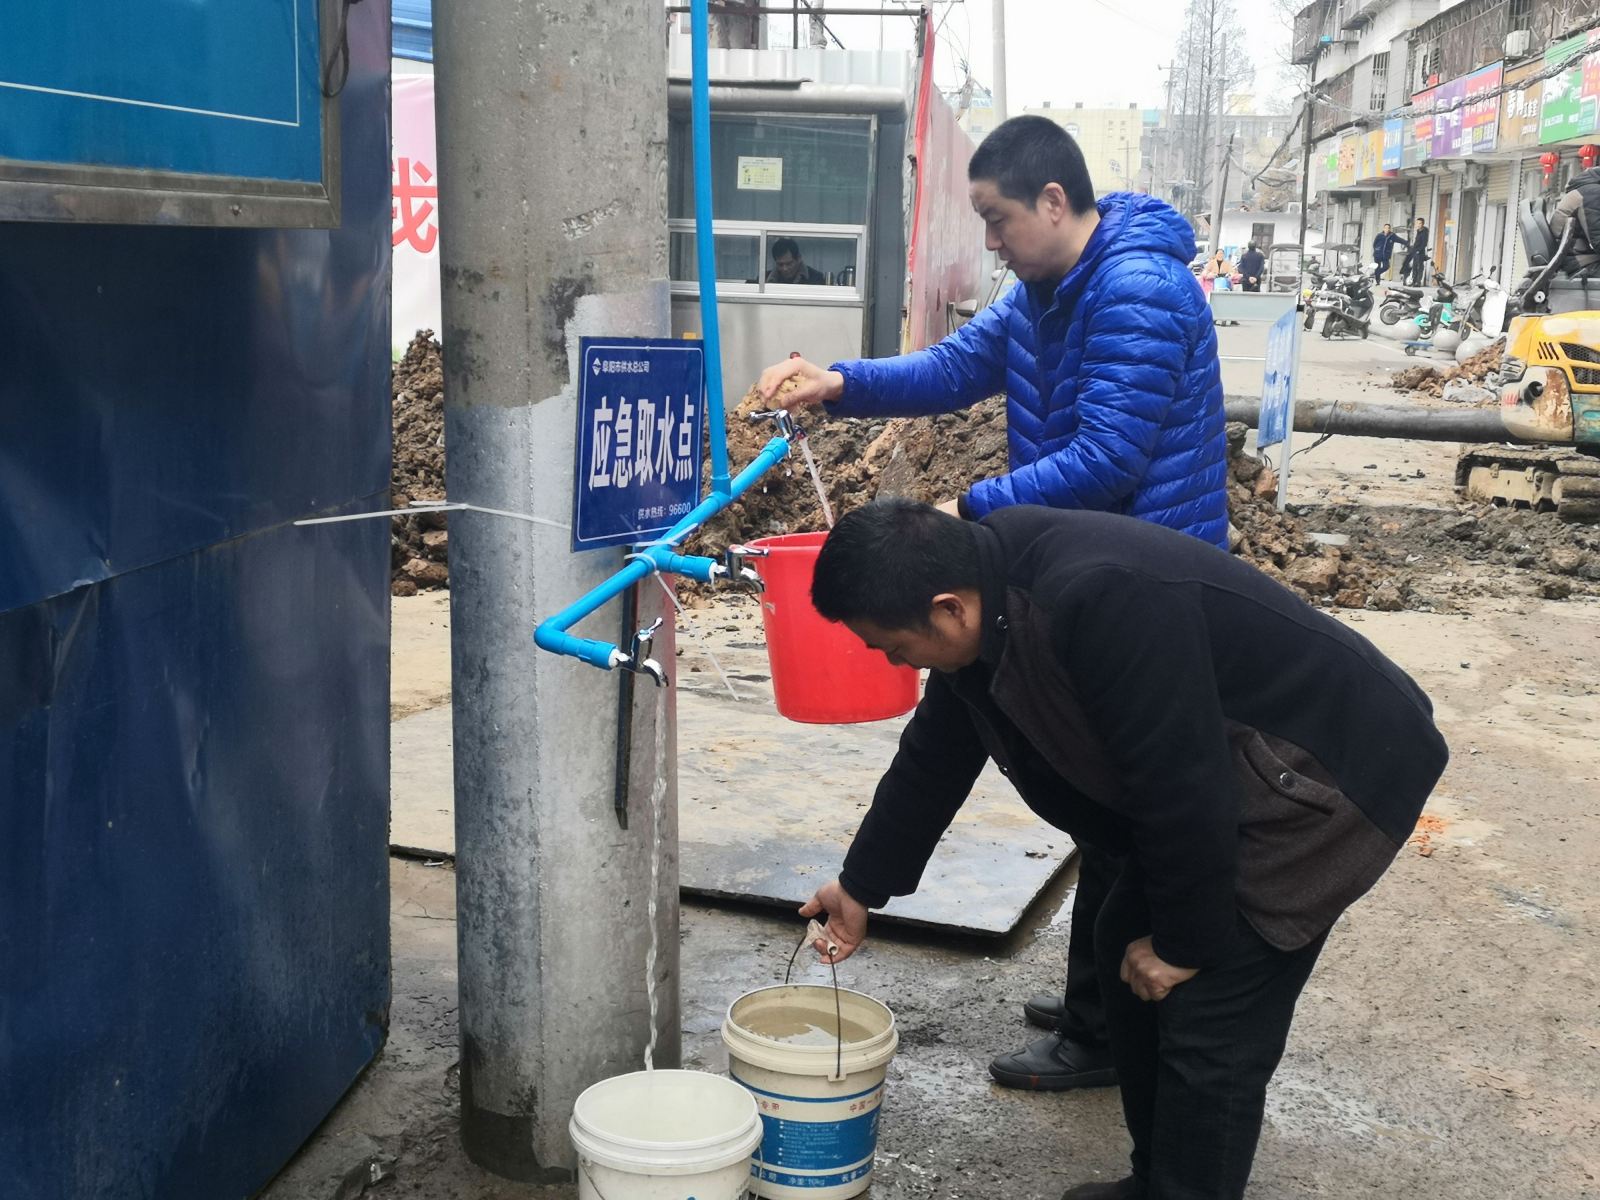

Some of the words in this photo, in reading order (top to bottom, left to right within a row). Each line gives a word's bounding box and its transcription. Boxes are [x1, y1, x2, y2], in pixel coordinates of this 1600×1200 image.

[602, 360, 650, 373] 阜阳市供水总公司
[588, 394, 695, 491] 应急取水点
